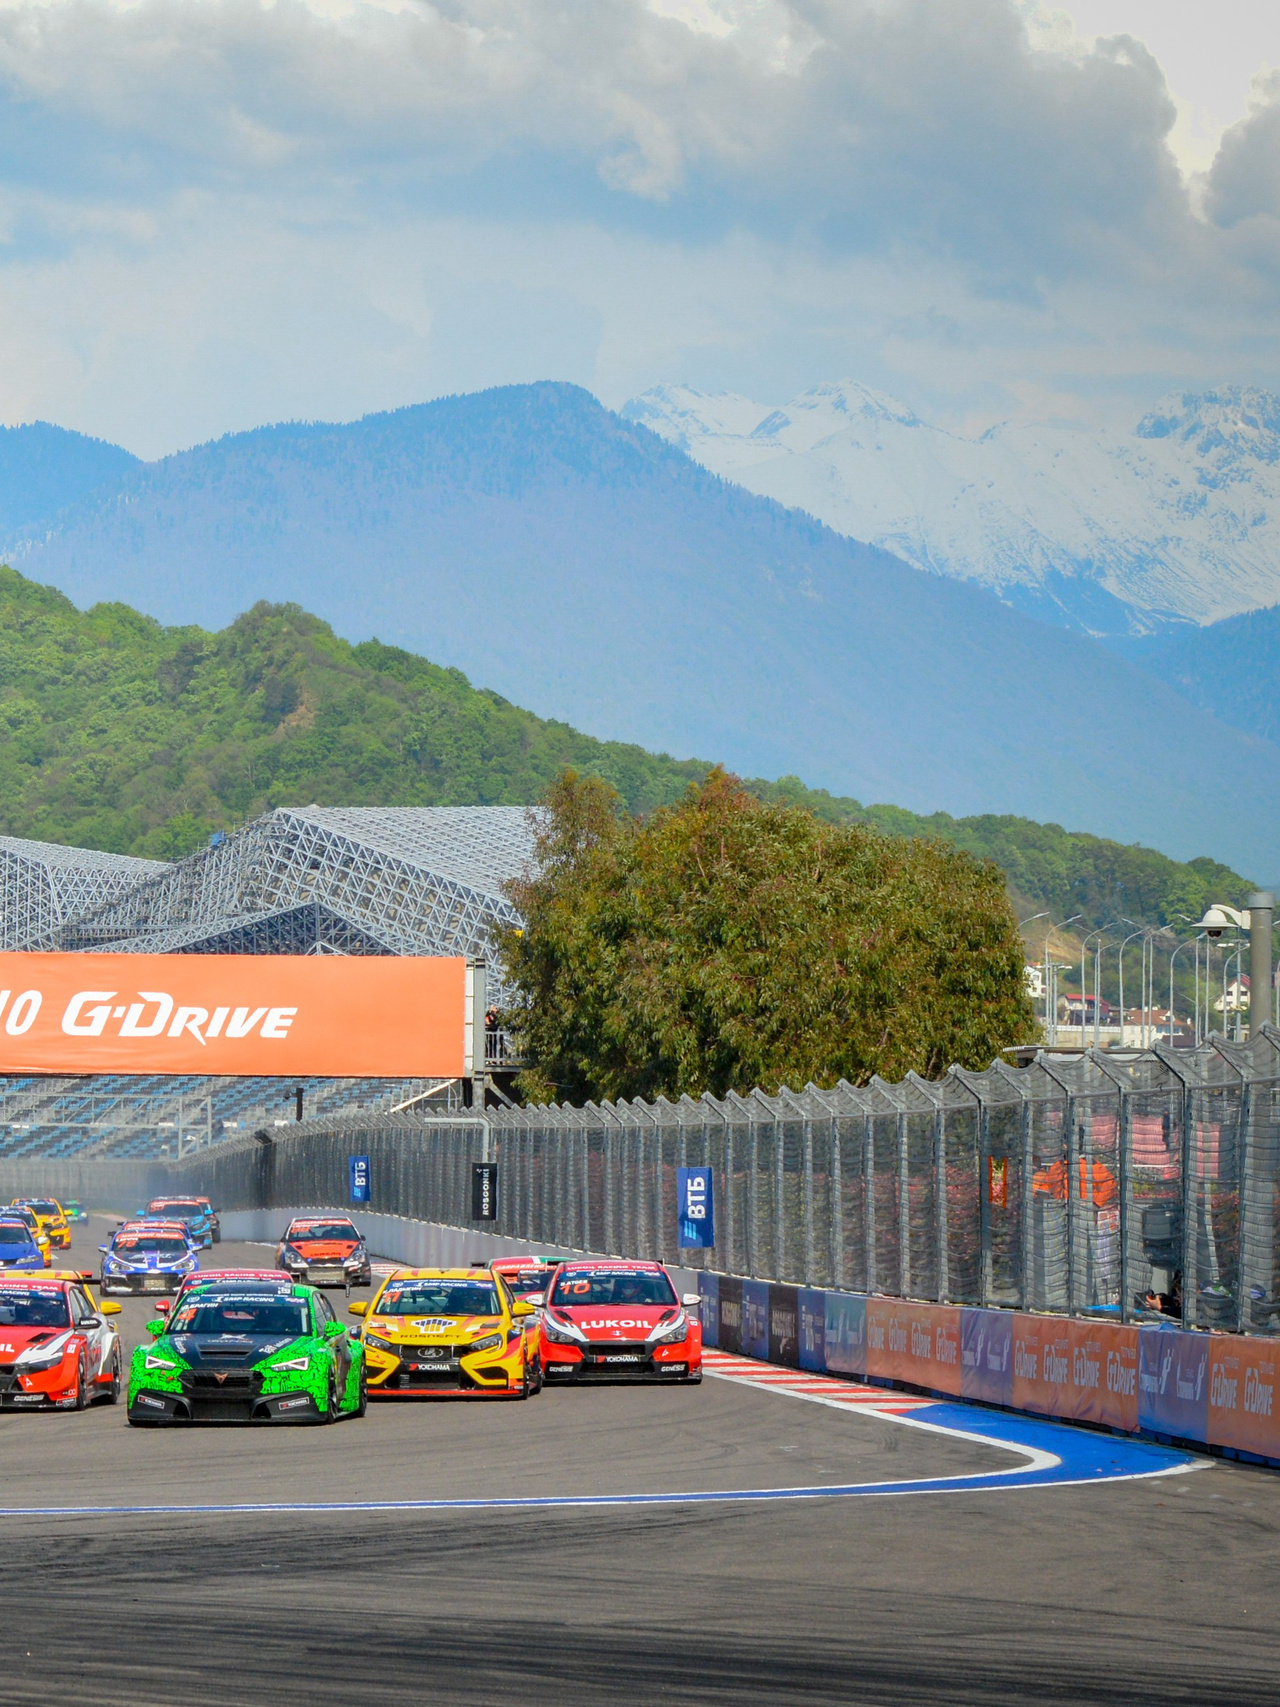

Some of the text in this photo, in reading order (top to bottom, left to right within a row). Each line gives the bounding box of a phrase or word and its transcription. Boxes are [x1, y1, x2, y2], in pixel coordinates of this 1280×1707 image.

[355, 1161, 367, 1187] ВТБ
[482, 1168, 490, 1216] ROSGONKI
[687, 1176, 706, 1219] ВТБ
[559, 1282, 591, 1295] 10
[581, 1319, 653, 1329] LUKOIL
[605, 1355, 639, 1363] YOKOHAMA
[417, 1363, 451, 1371] YOKOHAMA
[661, 1364, 686, 1373] GENESIS
[14, 1394, 45, 1402] GENESIS
